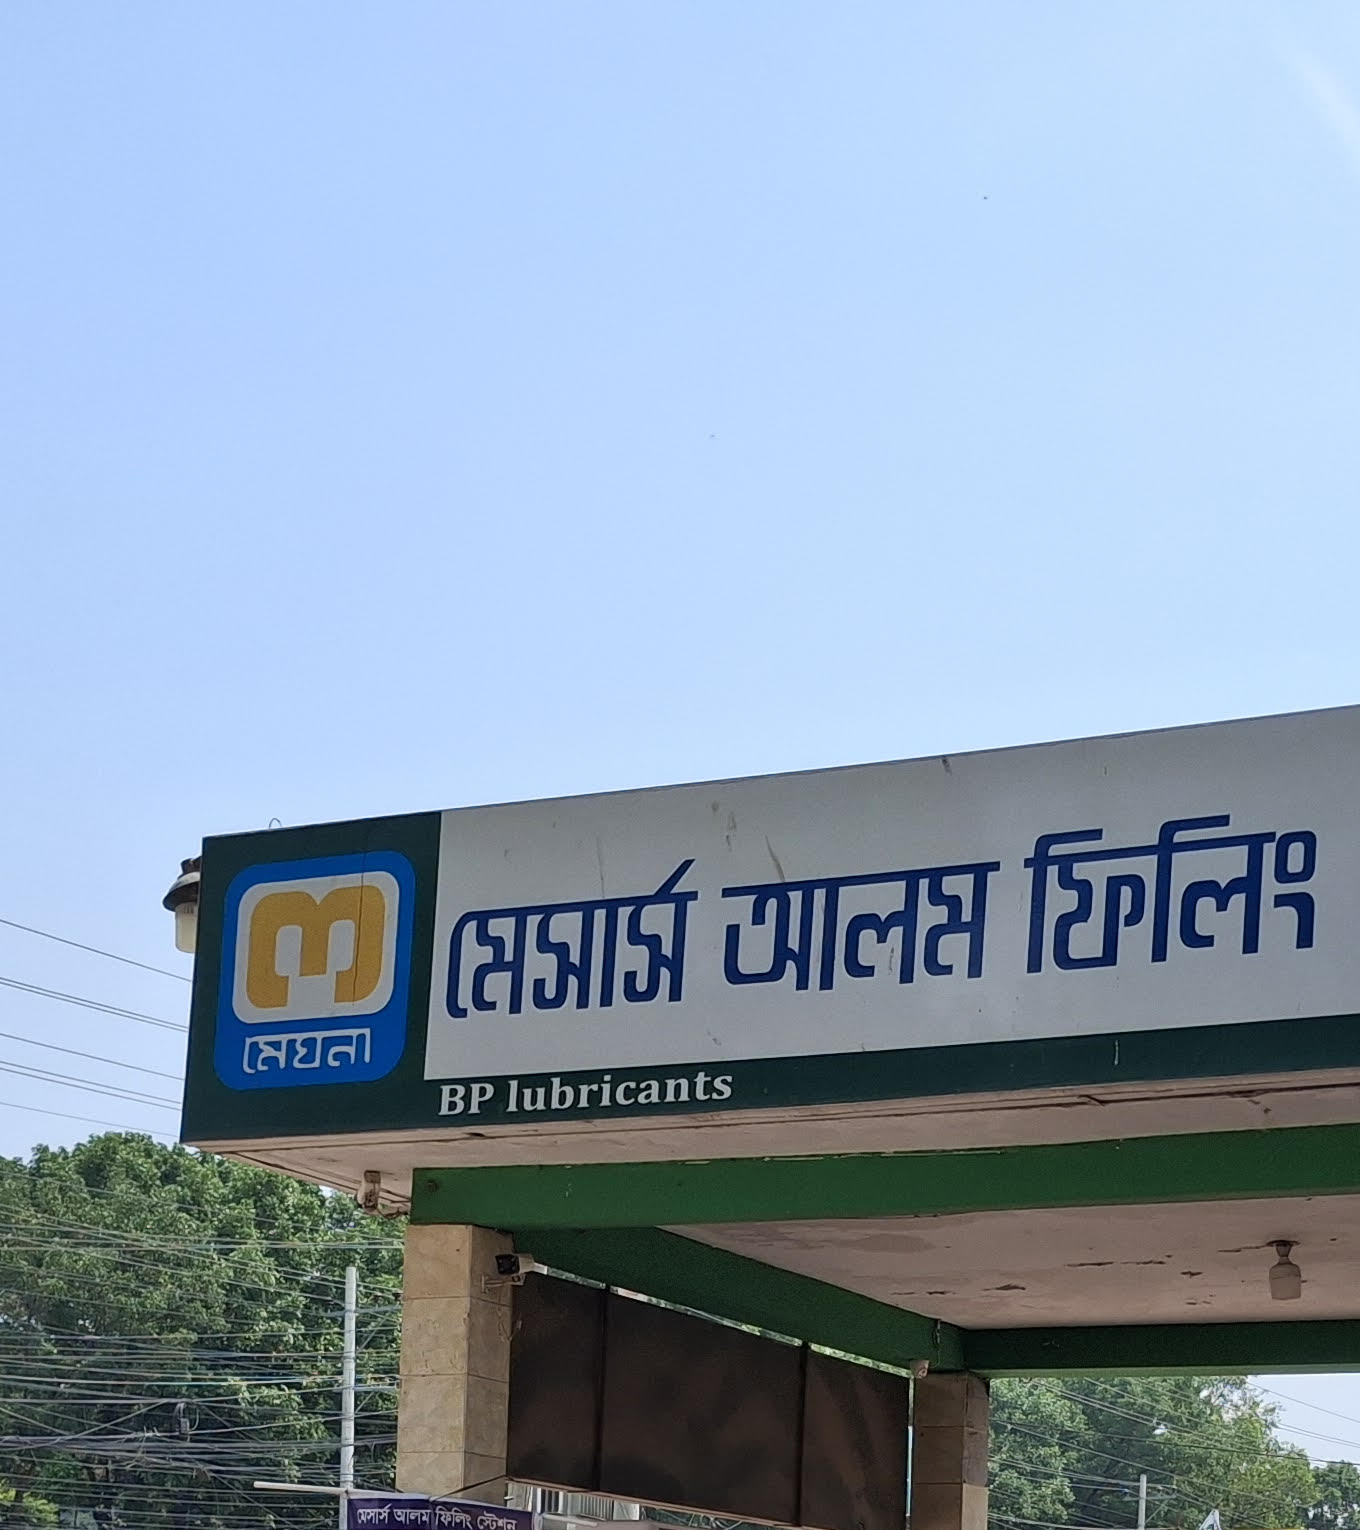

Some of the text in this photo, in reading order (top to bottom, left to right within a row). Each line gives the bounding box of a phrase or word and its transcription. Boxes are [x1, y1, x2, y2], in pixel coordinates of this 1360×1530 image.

[446, 859, 699, 1018] মেসার্স
[721, 861, 1001, 991] আলম
[1024, 814, 1318, 975] ফিলিং
[242, 1027, 372, 1074] মেঘনা
[438, 1071, 734, 1116] BP lubricants
[357, 1503, 391, 1524] মেসার্স
[393, 1509, 432, 1525] আলম
[435, 1506, 473, 1530] ফিলিং
